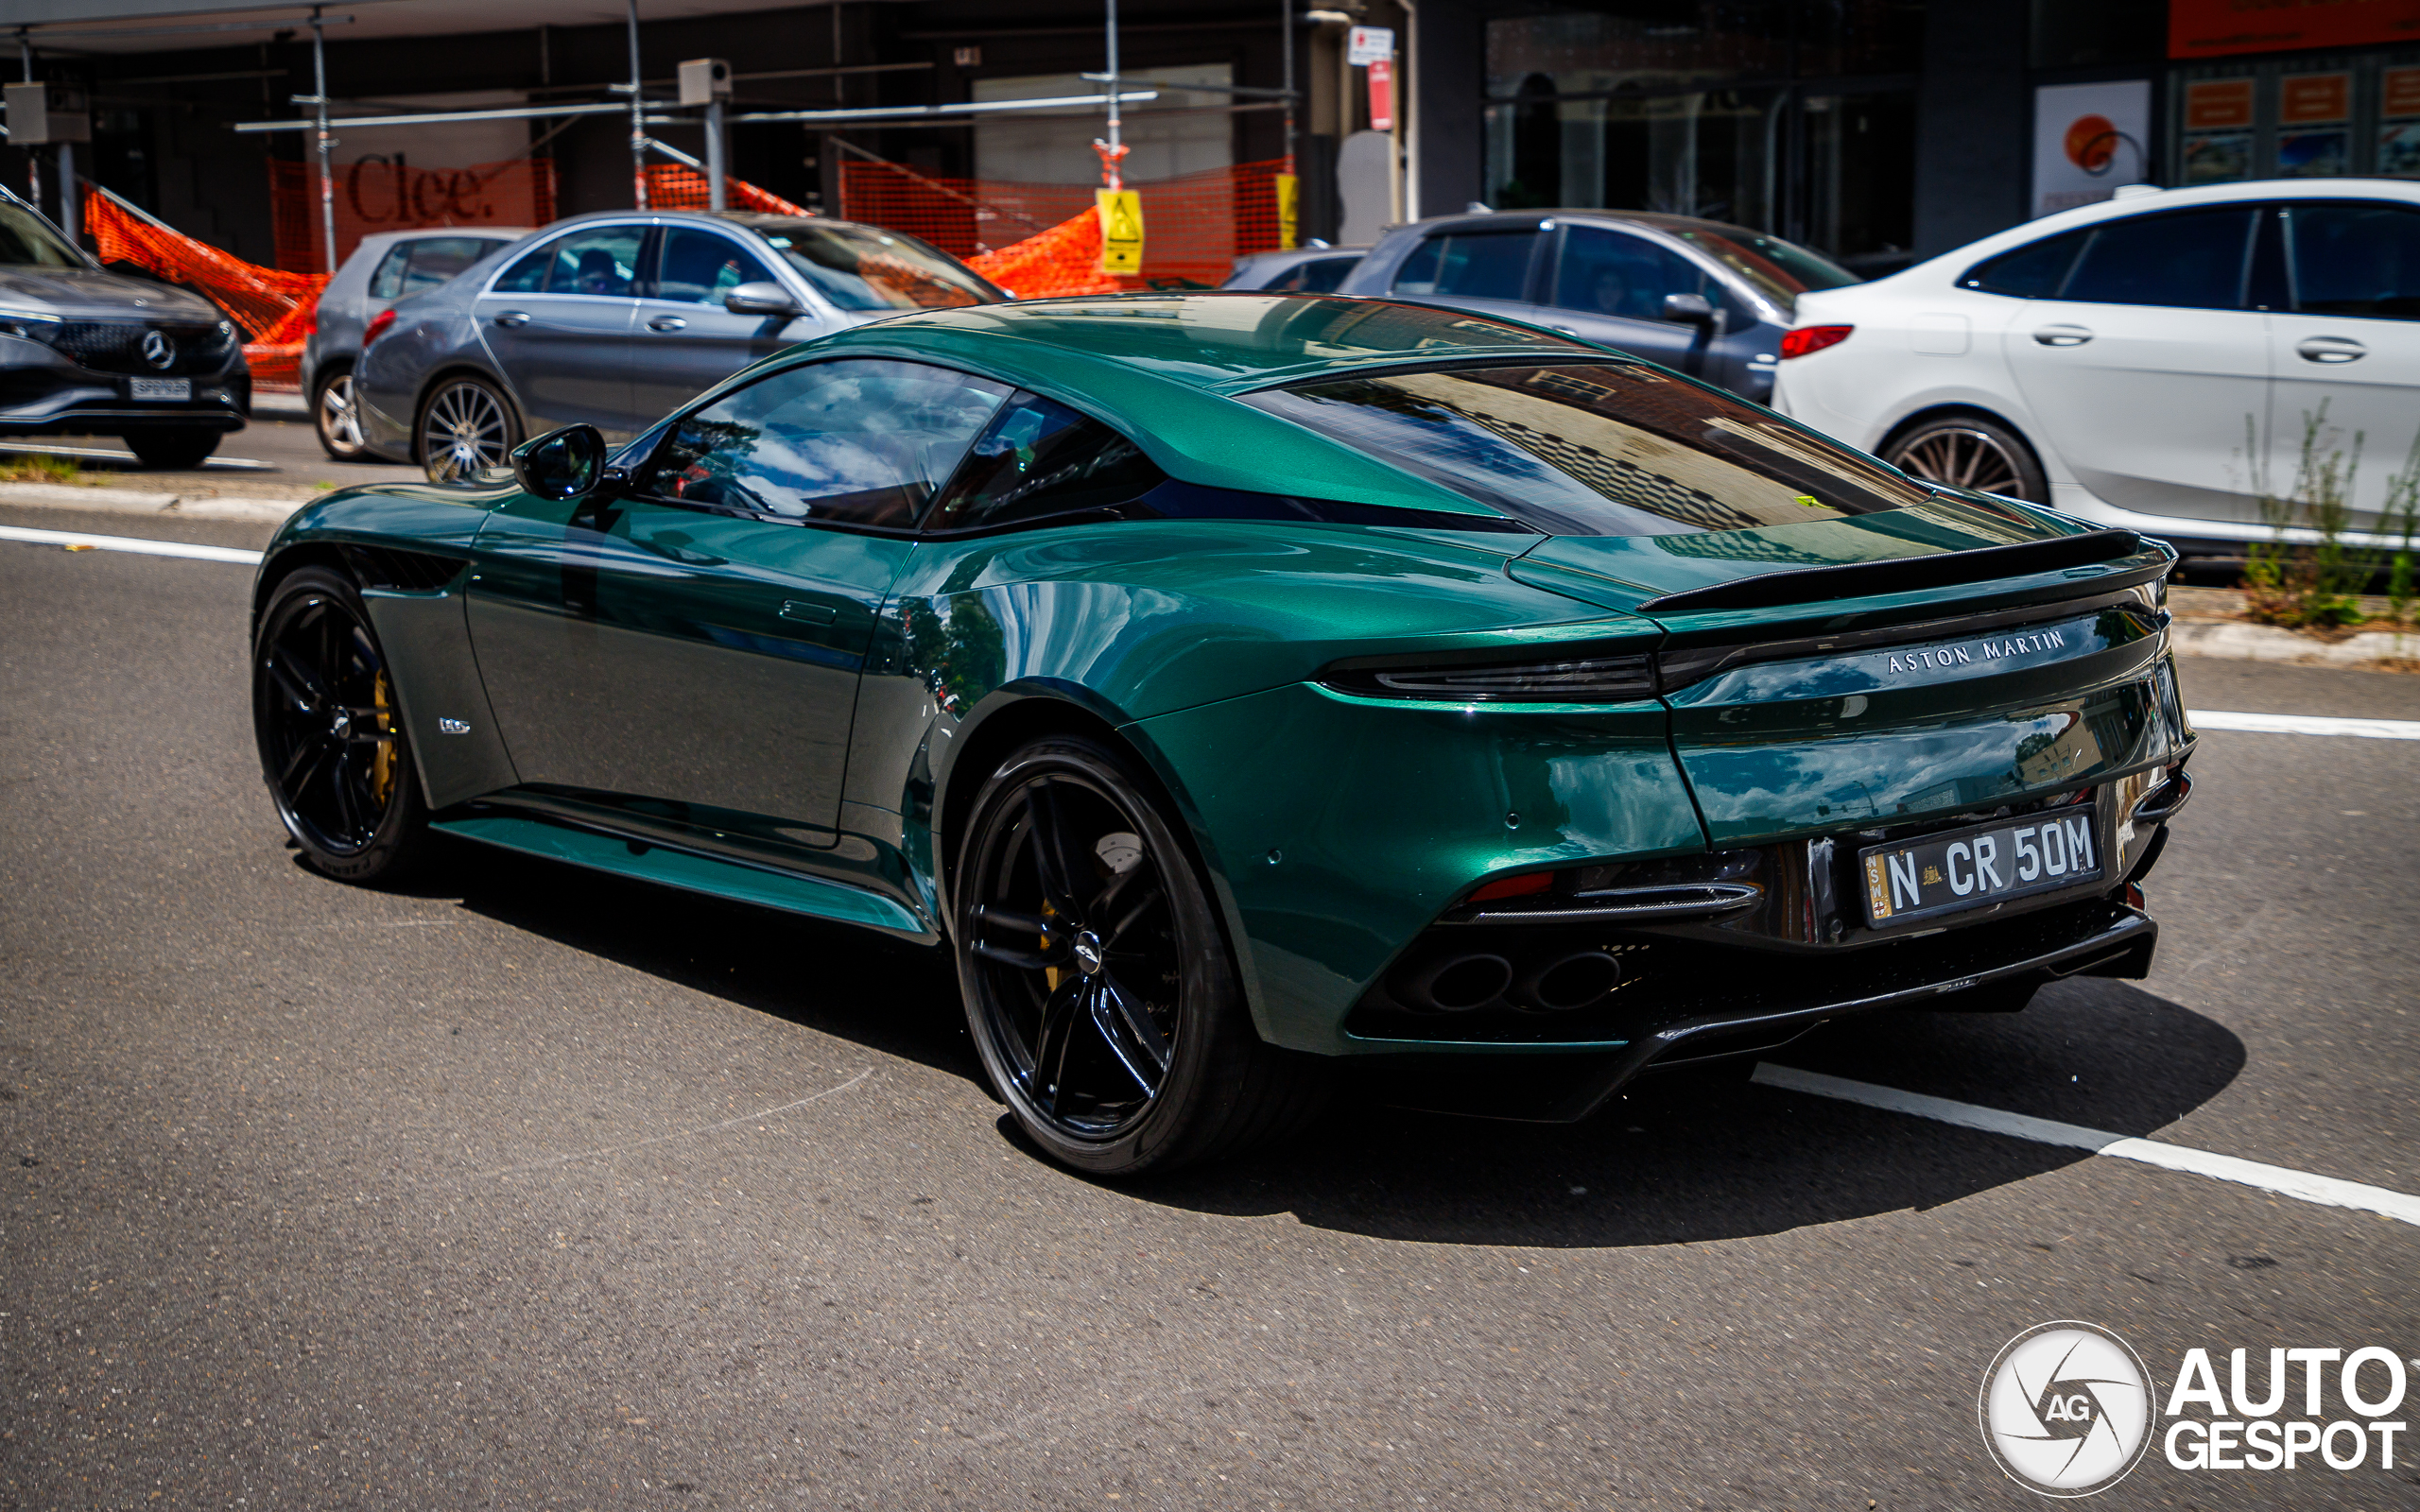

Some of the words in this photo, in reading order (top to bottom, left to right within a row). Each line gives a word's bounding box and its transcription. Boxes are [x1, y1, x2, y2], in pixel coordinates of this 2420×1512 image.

[1889, 646, 1971, 674] ASTON
[1982, 630, 2065, 660] MARTIN
[1889, 851, 1921, 909] N
[1946, 836, 2003, 896] CR
[2014, 816, 2095, 882] 50M
